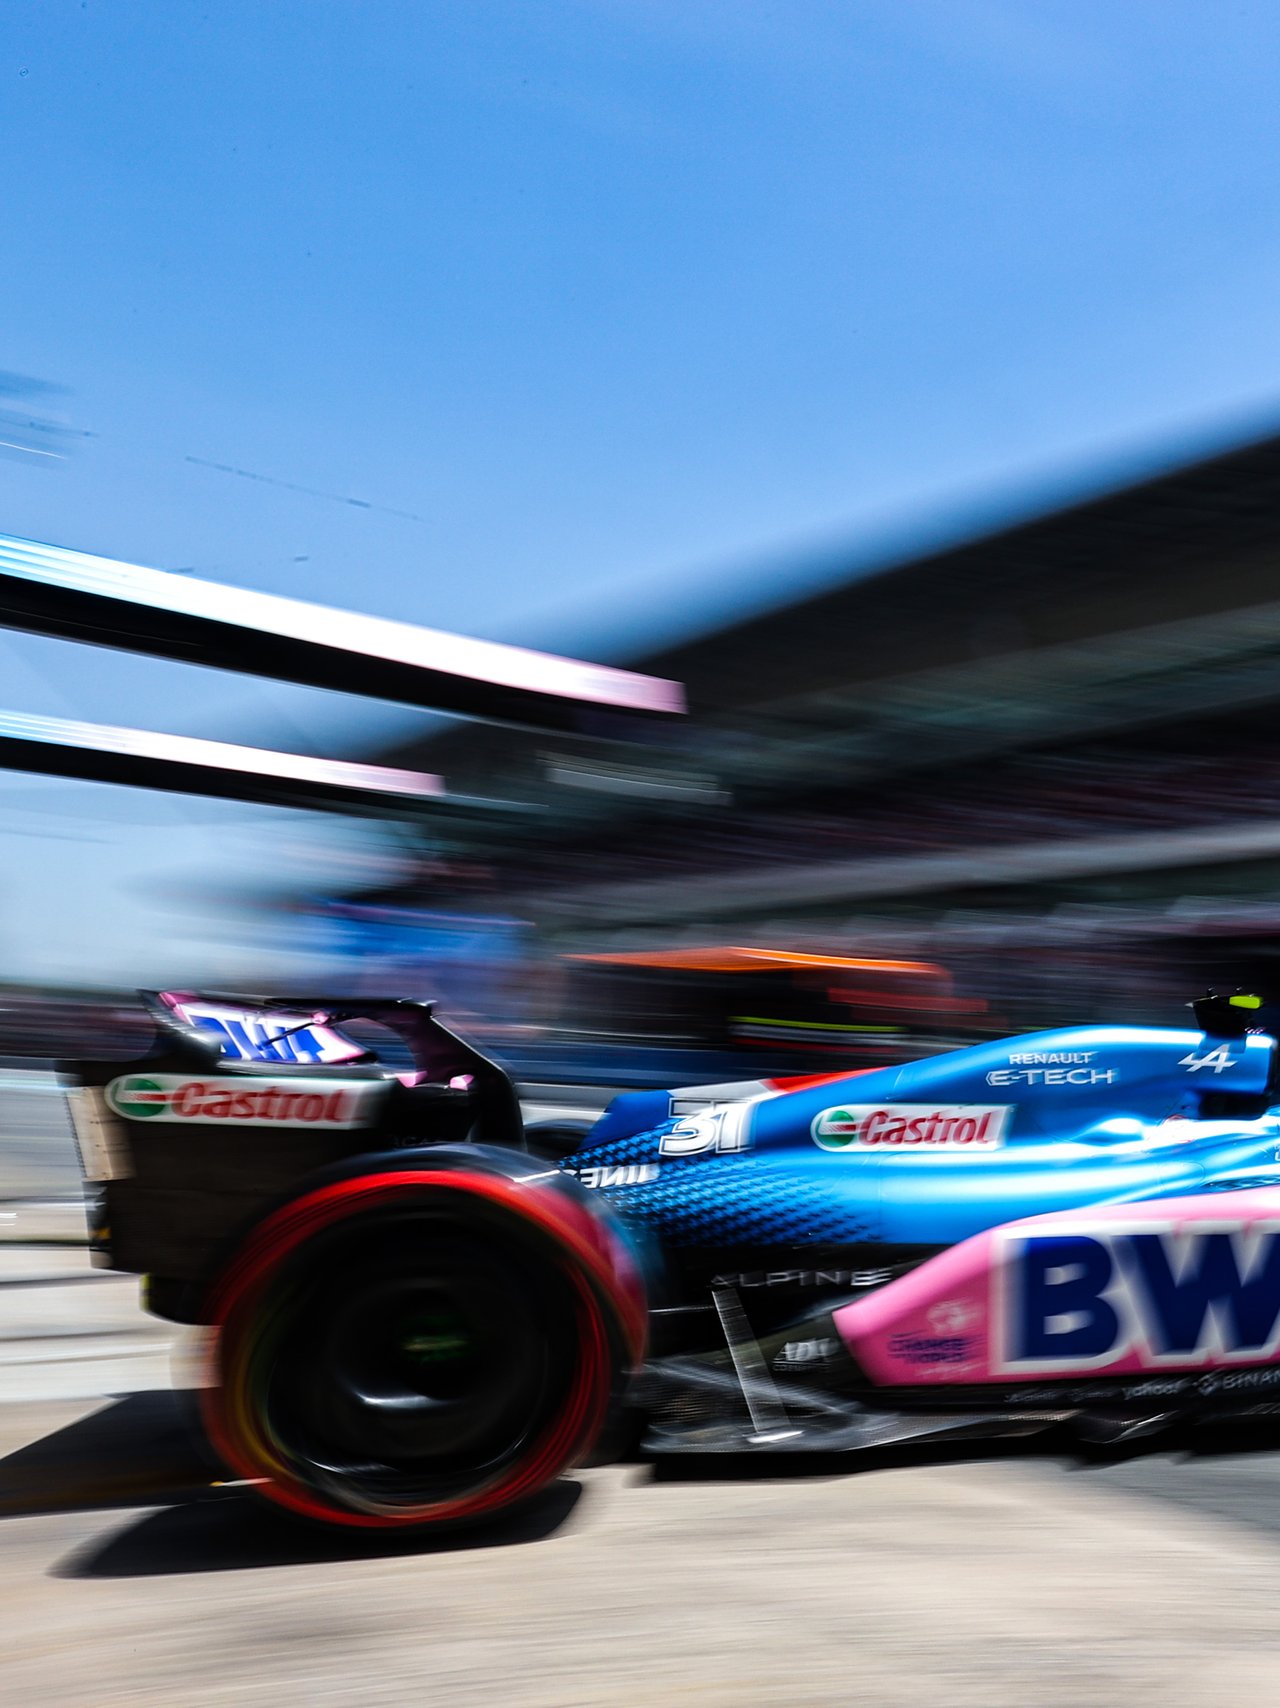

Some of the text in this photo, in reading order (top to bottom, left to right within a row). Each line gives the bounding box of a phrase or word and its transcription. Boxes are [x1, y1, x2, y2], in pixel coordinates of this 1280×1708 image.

[1008, 1052, 1093, 1065] RENAULT
[986, 1069, 1114, 1086] E-TECH
[170, 1082, 348, 1122] Castrol
[659, 1098, 752, 1156] 31
[858, 1110, 992, 1146] Castrol
[711, 1267, 893, 1288] ALPINE
